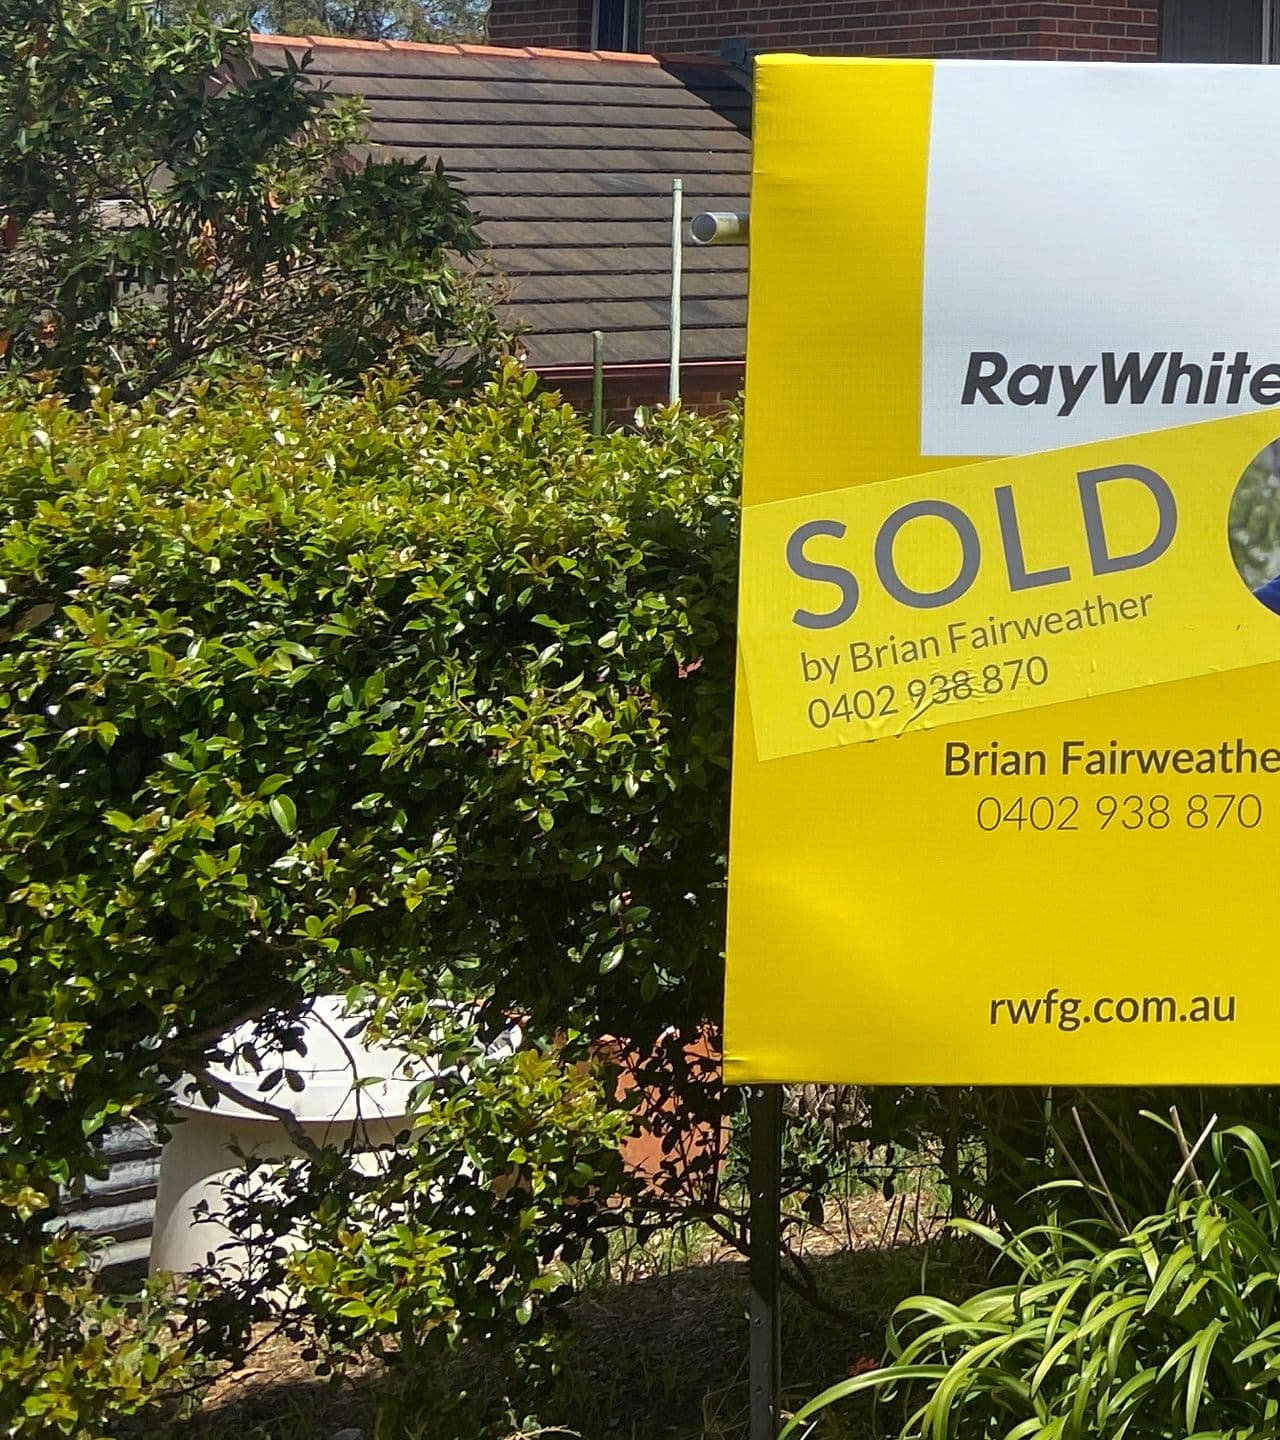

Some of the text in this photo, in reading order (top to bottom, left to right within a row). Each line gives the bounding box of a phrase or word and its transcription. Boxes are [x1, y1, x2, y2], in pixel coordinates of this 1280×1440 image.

[786, 464, 1178, 630] SOLD
[801, 594, 1153, 684] by Brian Fairweather
[808, 656, 1048, 728] 0402 938 870
[944, 741, 1046, 776] Brian
[977, 794, 1262, 831] 0402 938 870
[990, 988, 1235, 1032] rwfg.com.au
